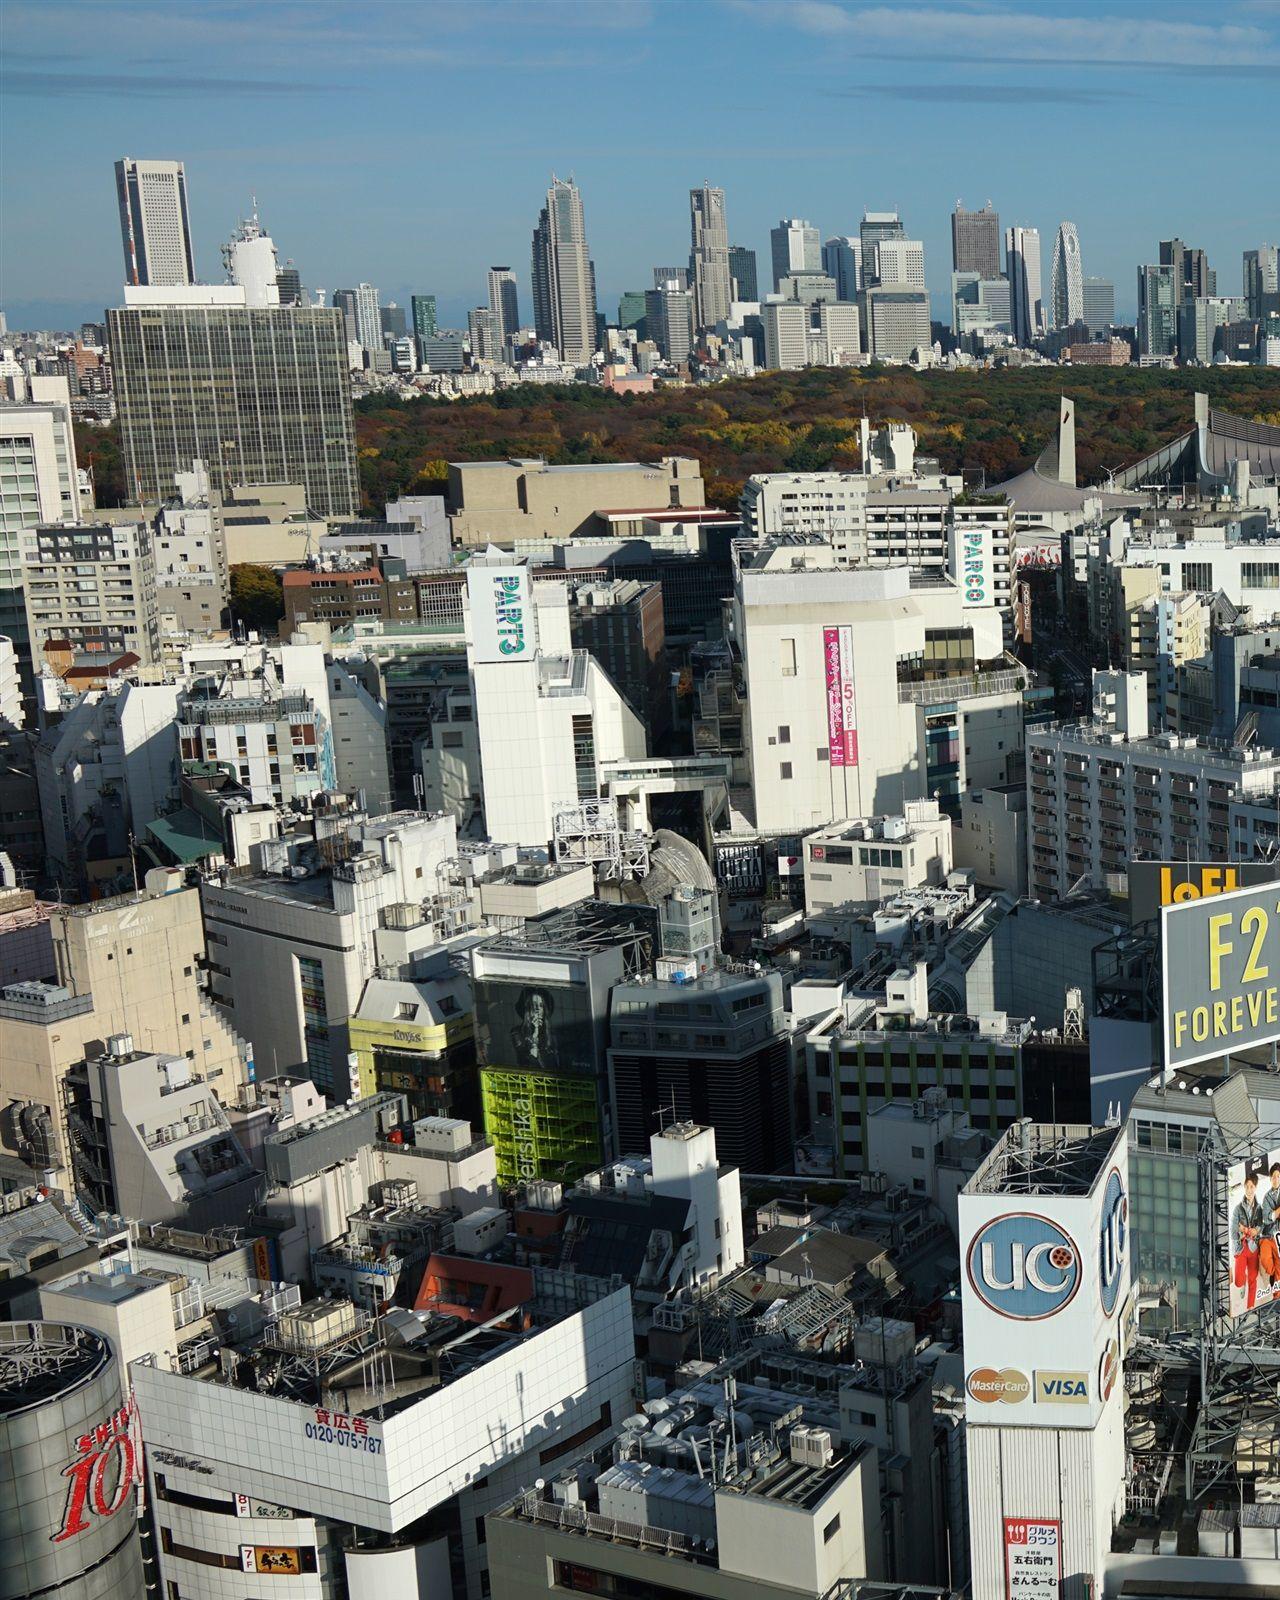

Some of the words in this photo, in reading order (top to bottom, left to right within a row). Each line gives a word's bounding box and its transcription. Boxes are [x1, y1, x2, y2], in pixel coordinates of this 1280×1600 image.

[964, 533, 985, 601] PARCO
[494, 576, 525, 655] PART3
[1256, 1286, 1273, 1299] 2nd
[970, 1379, 1029, 1393] MasterCard
[1043, 1380, 1087, 1396] VISA
[314, 1408, 369, 1435] 貸広告
[1014, 1556, 1053, 1566] 五右衛門
[1012, 1577, 1058, 1587] さんるーむ
